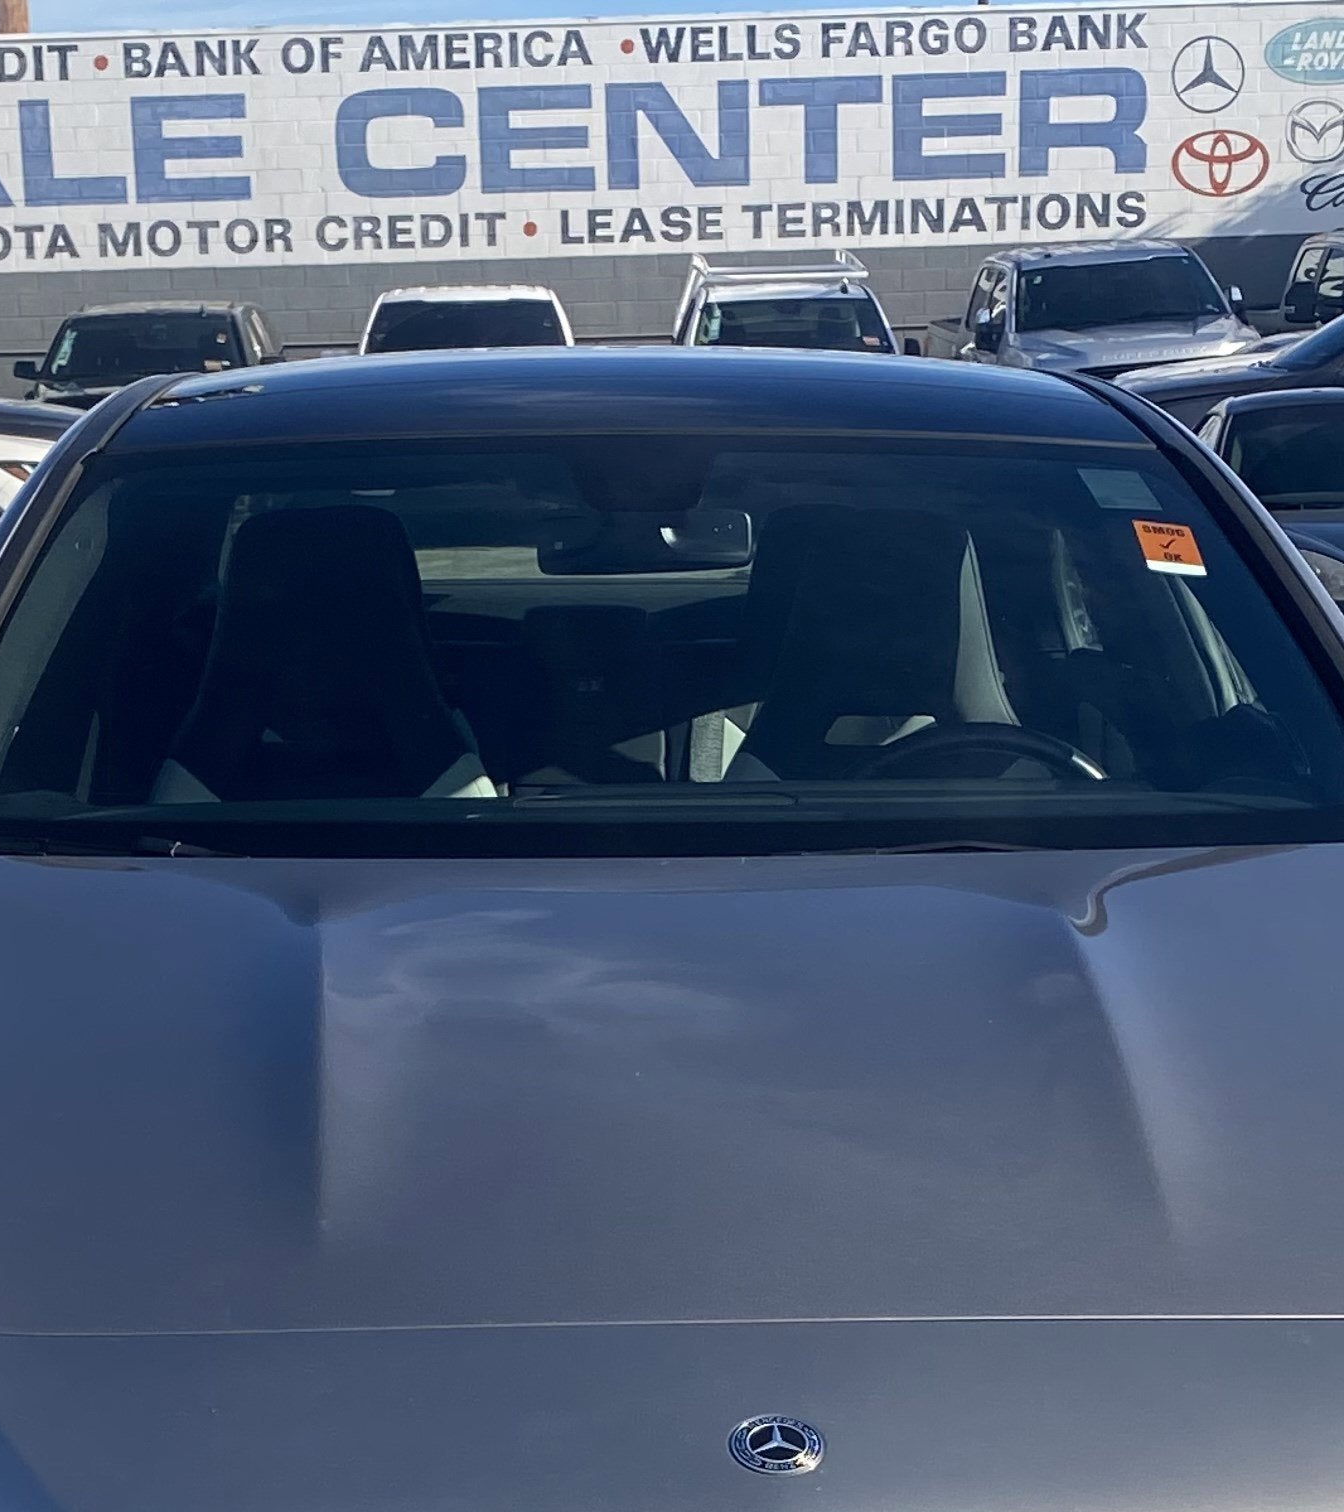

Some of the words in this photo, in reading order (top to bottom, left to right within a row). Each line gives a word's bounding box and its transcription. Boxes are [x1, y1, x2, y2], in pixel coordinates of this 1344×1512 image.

[123, 40, 260, 78] BANK
[282, 38, 343, 73] OF
[360, 30, 593, 72] AMERICA
[640, 24, 800, 63] WELLS
[822, 18, 986, 57] FARGO
[1009, 14, 1146, 52] BANK
[336, 67, 1146, 195] CENTER
[98, 219, 292, 257] MOTOR
[316, 212, 506, 251] CREDIT
[561, 207, 723, 244] LEASE
[742, 191, 1146, 238] TERMINATIONS
[1141, 525, 1186, 537] SMOG
[1163, 551, 1183, 562] OK
